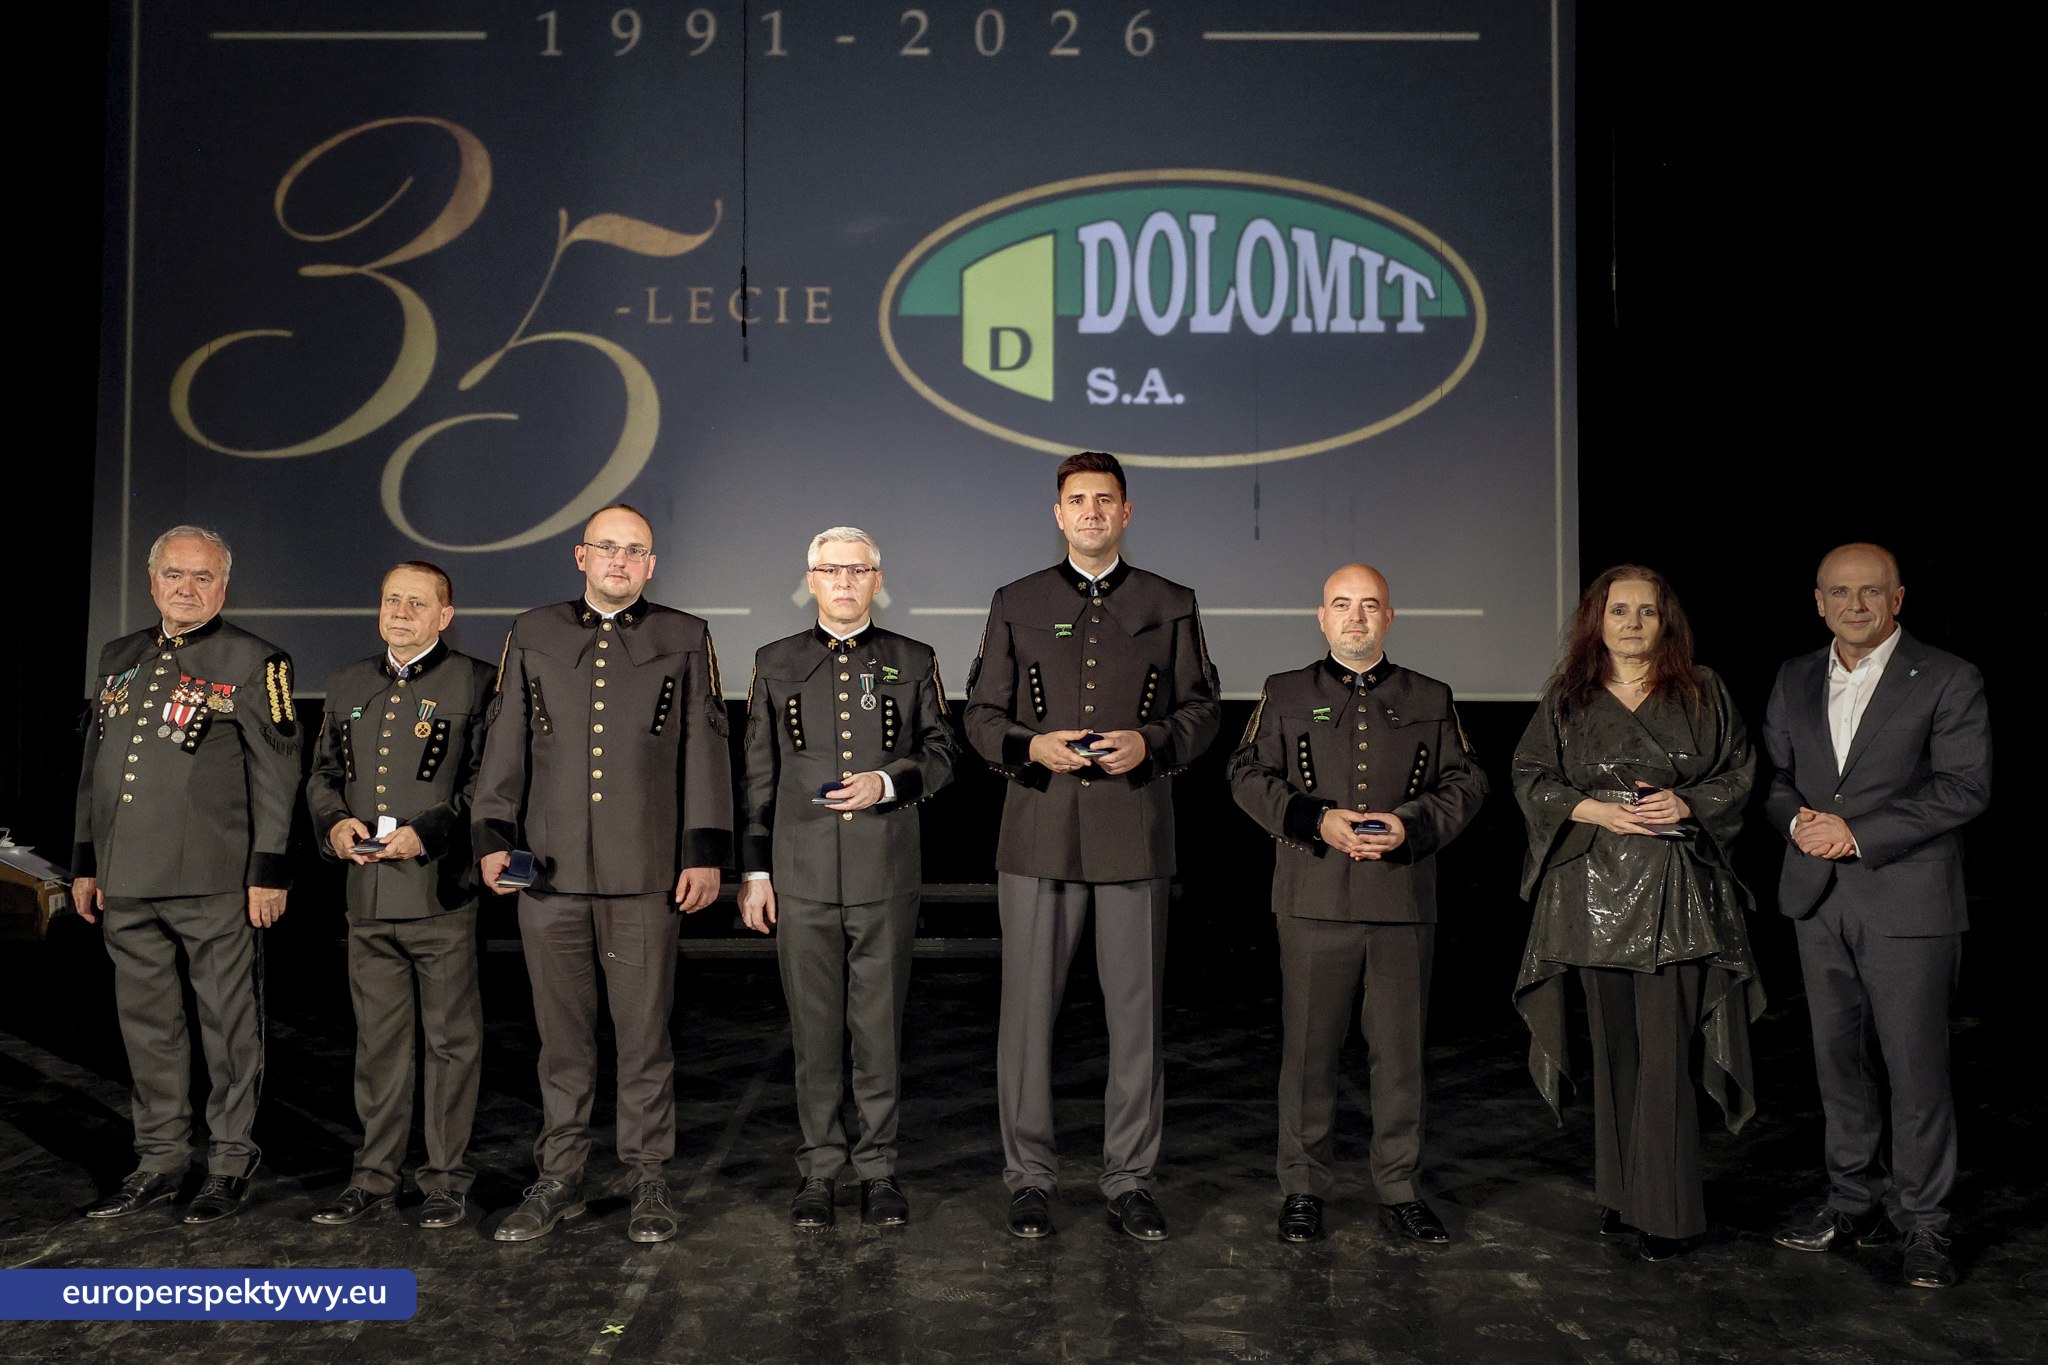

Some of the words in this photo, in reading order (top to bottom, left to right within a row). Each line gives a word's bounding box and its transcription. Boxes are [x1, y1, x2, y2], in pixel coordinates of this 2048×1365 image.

[536, 9, 1156, 57] 1991-2026
[1077, 211, 1435, 336] DOLOMIT
[170, 116, 723, 553] 35
[616, 286, 832, 324] -LECIE
[988, 326, 1033, 371] D
[1085, 368, 1185, 405] S.A.
